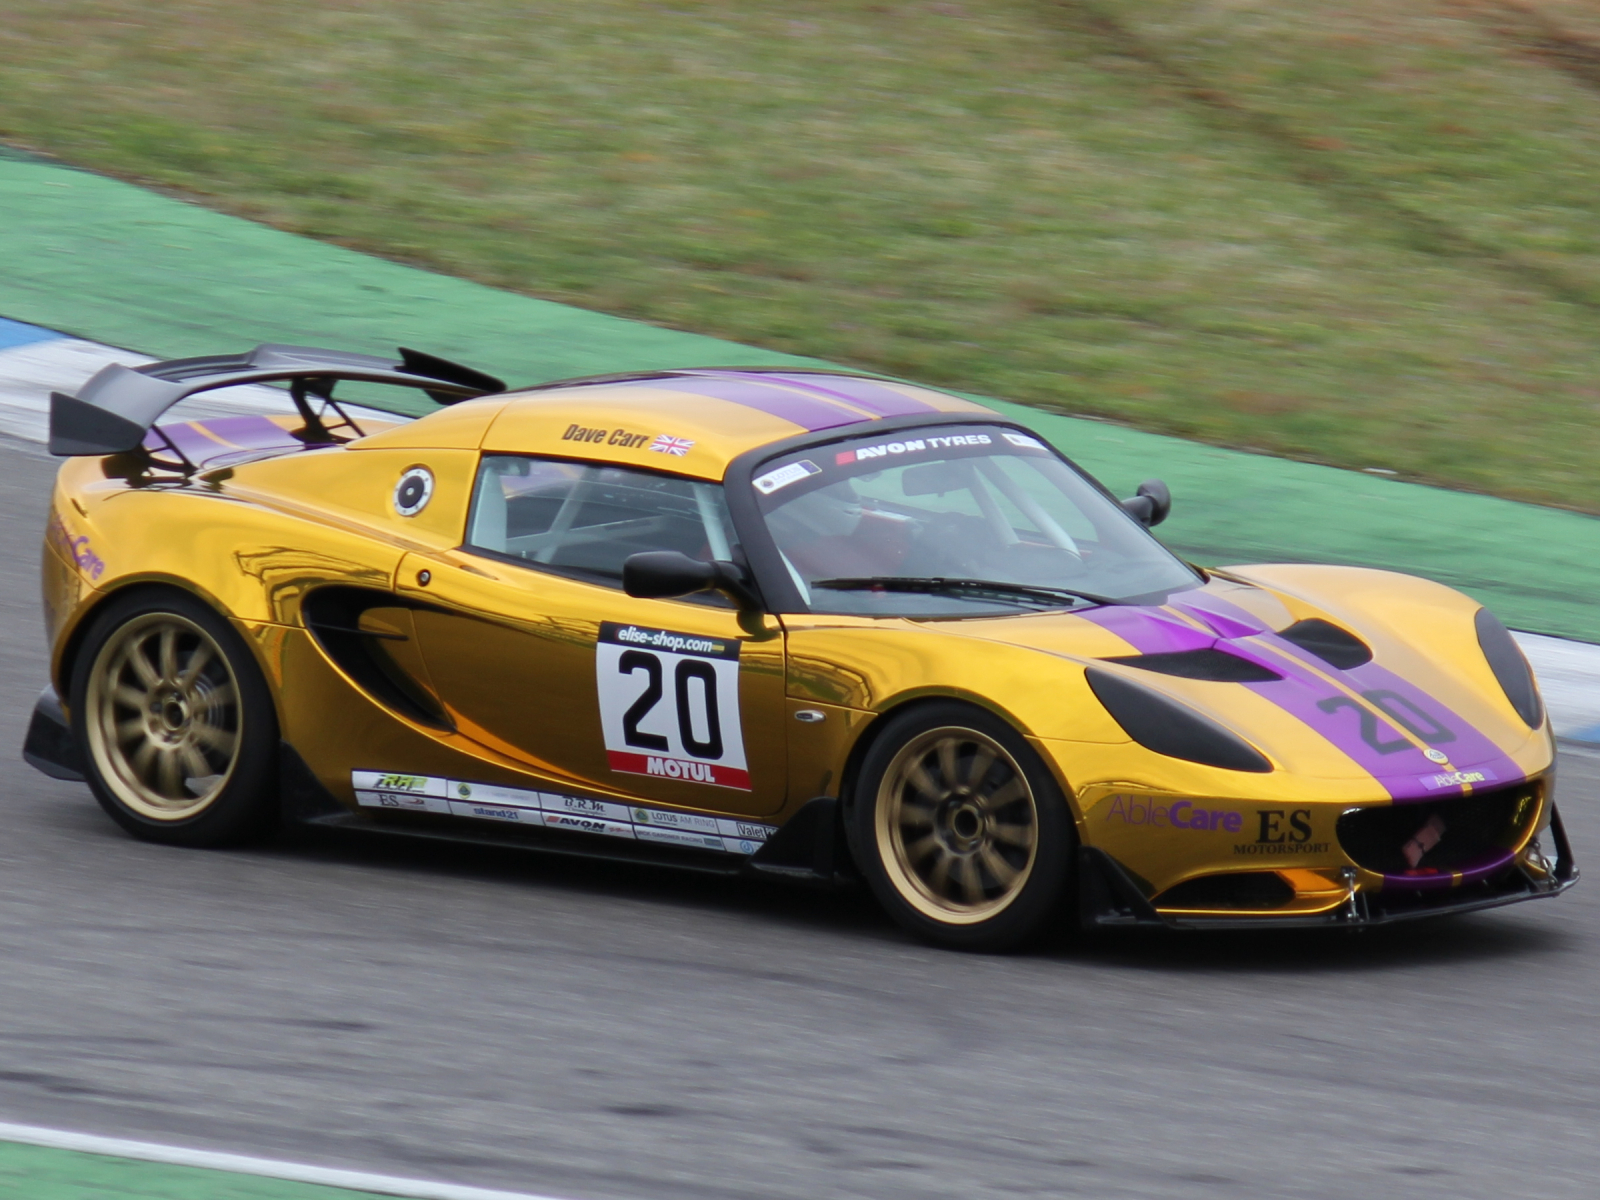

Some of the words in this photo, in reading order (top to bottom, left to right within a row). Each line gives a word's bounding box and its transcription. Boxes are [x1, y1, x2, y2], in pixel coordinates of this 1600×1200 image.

[561, 424, 607, 444] Dave
[607, 428, 650, 449] Carr
[856, 439, 926, 461] AVON
[927, 434, 992, 448] TYRES
[618, 626, 713, 652] elise-shop.com
[618, 649, 724, 760] 20
[1316, 689, 1457, 756] 20
[647, 757, 715, 783] MOTUL
[1433, 771, 1486, 787] AbleCare
[379, 794, 400, 807] ES
[474, 807, 519, 819] stand21
[560, 818, 606, 830] AVON
[652, 811, 678, 822] LOTUS
[694, 818, 715, 828] RING
[1106, 795, 1243, 832] AbleCare
[739, 825, 766, 839] Valet
[1256, 809, 1312, 845] ES
[1234, 842, 1331, 855] MOTORSPORT
